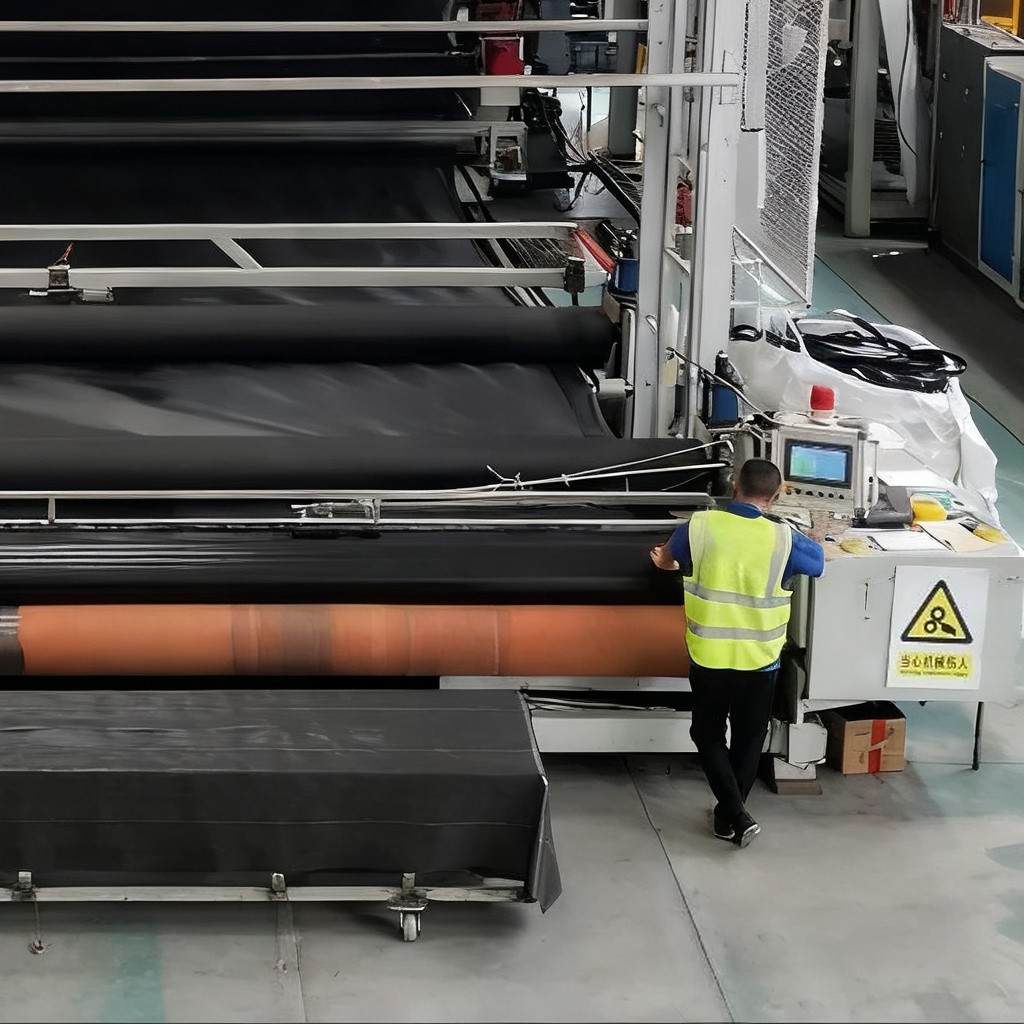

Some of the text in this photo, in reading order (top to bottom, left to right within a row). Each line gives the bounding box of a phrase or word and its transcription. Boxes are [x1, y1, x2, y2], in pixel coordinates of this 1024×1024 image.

[901, 654, 968, 669] 当心机械伤人
